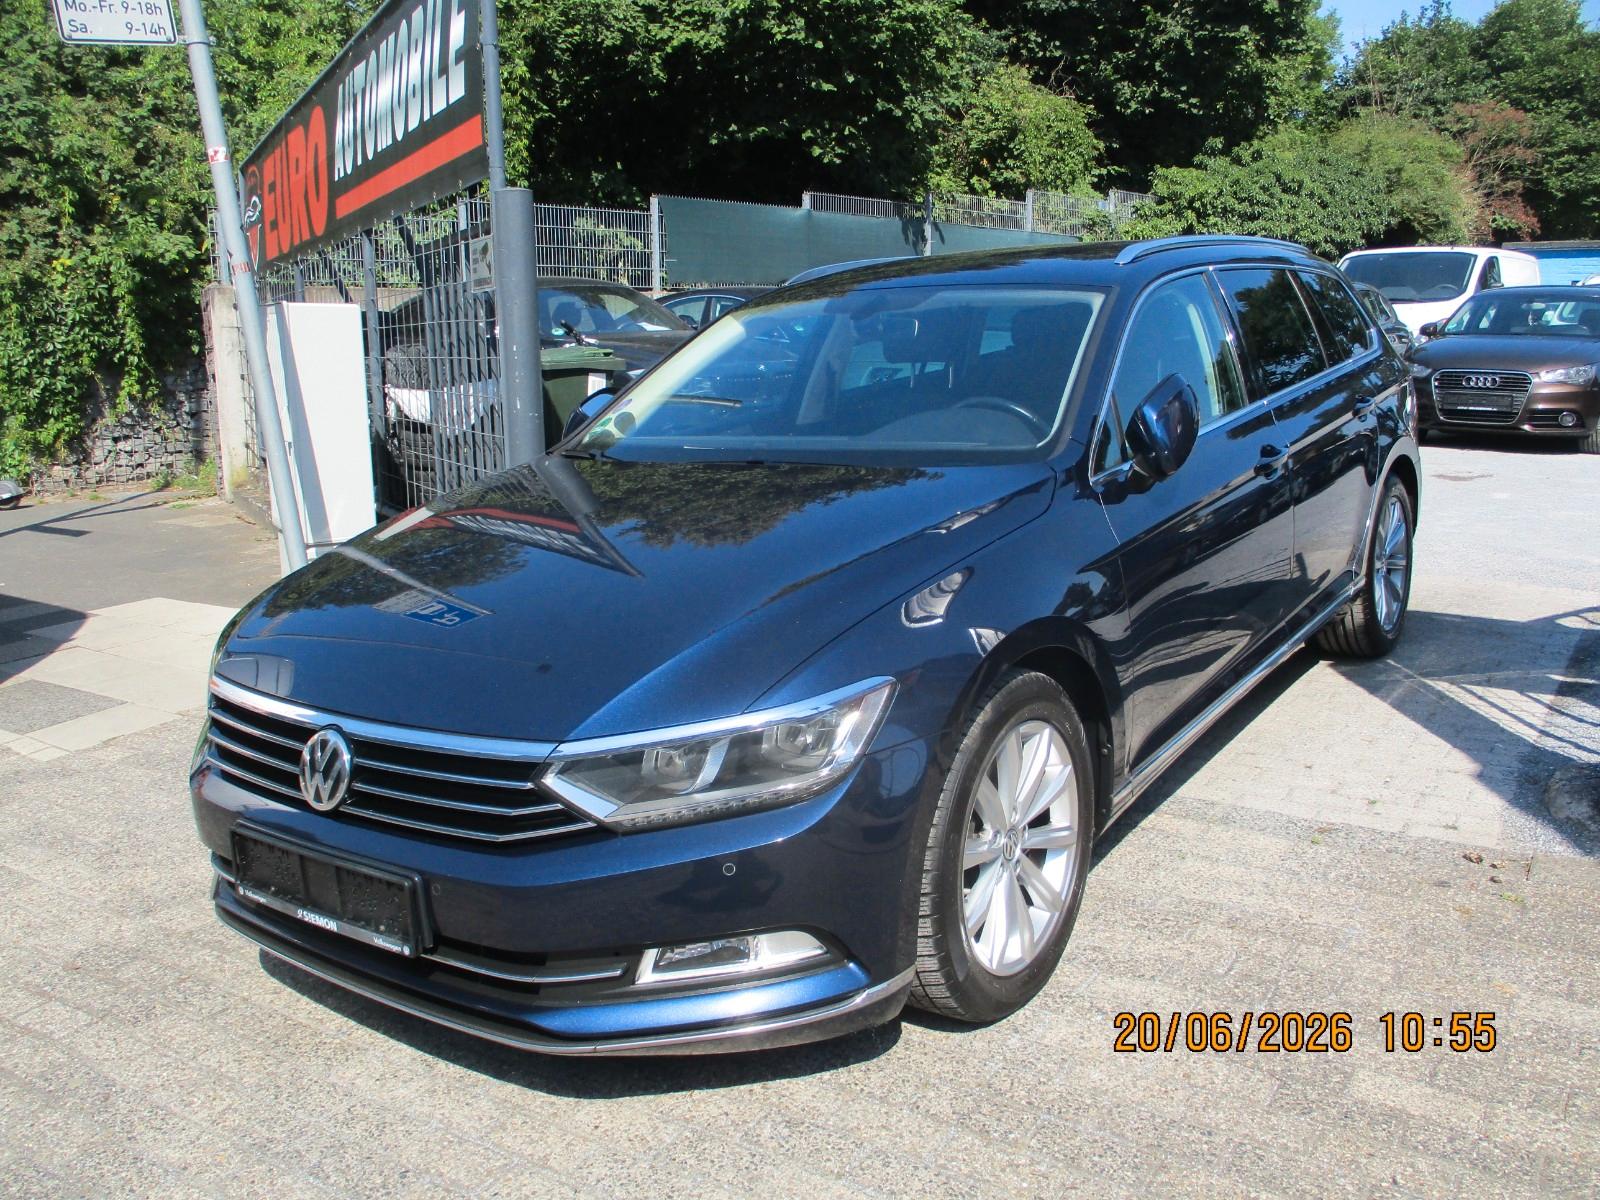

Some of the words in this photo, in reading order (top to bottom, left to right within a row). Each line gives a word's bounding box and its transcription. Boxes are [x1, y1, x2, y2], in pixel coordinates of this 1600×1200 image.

[64, 0, 118, 13] Mo.-Fr.
[121, 1, 163, 16] 9-18h
[68, 19, 93, 34] Sa.
[125, 22, 167, 36] 9-14h
[263, 105, 329, 261] EURO
[334, 0, 466, 182] AUTOMOBILE
[303, 910, 338, 932] SIEMON
